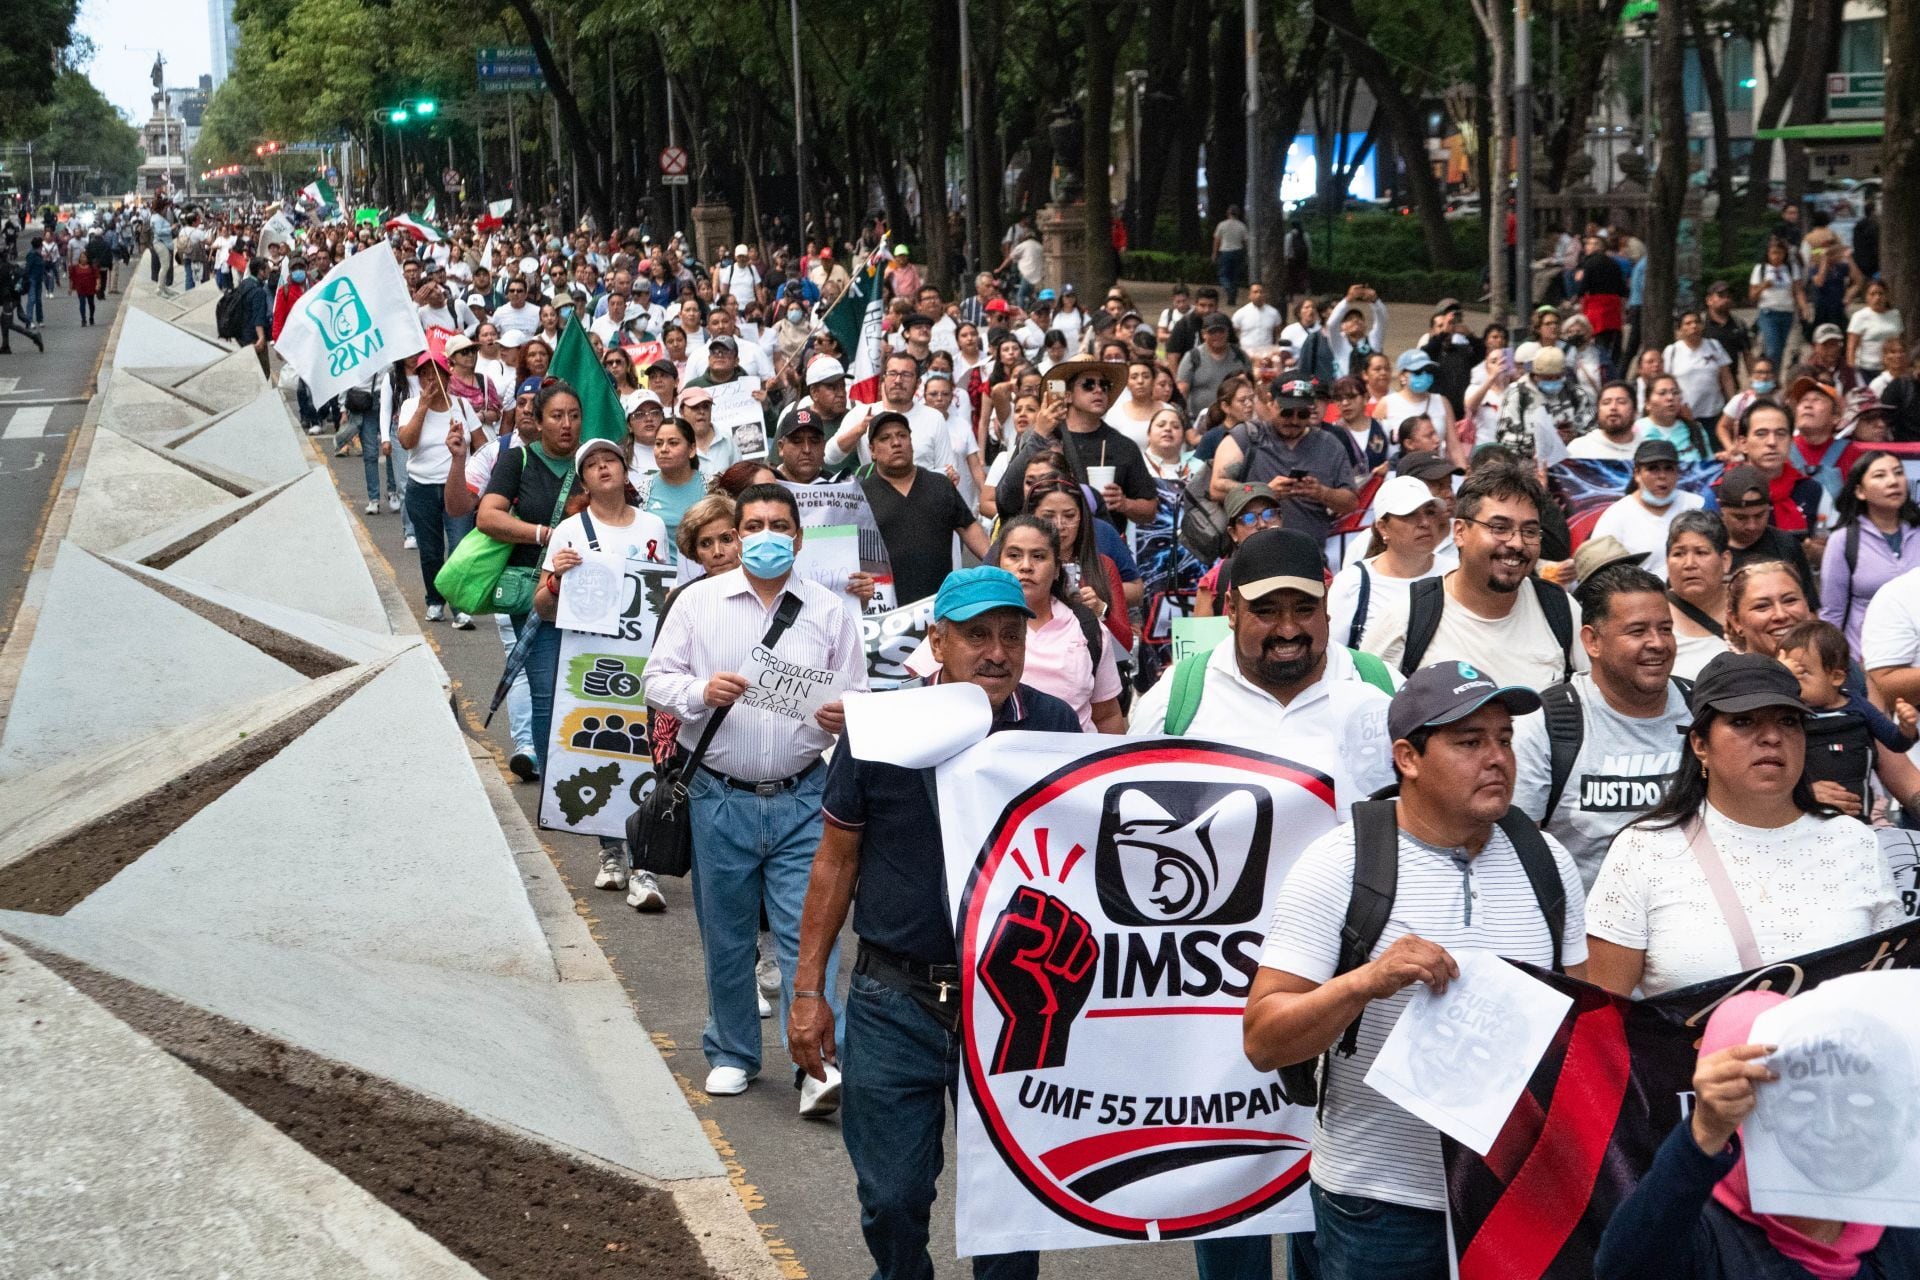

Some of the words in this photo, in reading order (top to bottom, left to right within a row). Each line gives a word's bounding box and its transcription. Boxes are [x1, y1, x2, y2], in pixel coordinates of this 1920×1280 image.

[794, 491, 835, 500] EDICINA
[752, 646, 834, 685] CARDIOLOGIA
[759, 669, 812, 698] CMN
[742, 698, 806, 721] NUTRICION
[1582, 781, 1630, 807] JUST
[1630, 781, 1661, 806] DO
[1102, 930, 1265, 999] IMSS
[1788, 1052, 1872, 1080] OLIVO
[1018, 1075, 1094, 1120] UMF
[1097, 1092, 1137, 1126] 55
